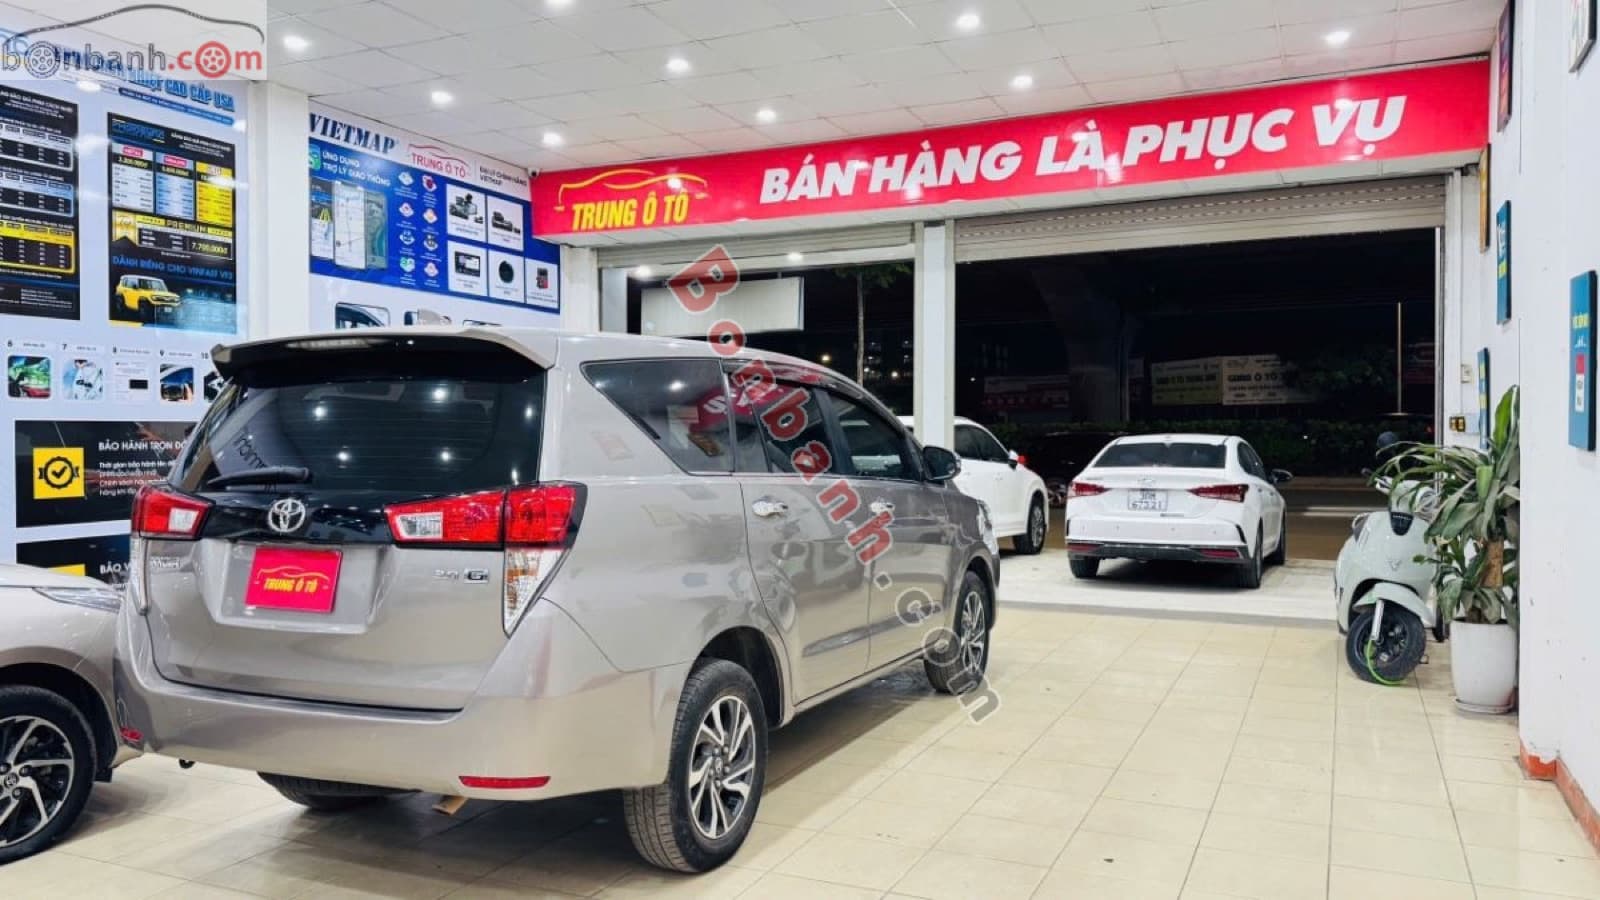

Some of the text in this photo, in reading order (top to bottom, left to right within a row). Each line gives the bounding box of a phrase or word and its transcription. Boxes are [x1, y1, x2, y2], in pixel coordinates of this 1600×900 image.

[165, 79, 187, 98] CAO
[213, 91, 235, 112] USA
[309, 112, 395, 154] VIETMAP
[411, 153, 443, 172] TRUNG
[759, 95, 1407, 204] BÁN HÀNG LÀ PHỤC VỤ
[572, 187, 689, 231] TRUNG Ô TÔ
[98, 439, 120, 451] BẢO
[121, 439, 148, 451] HÀNH
[100, 560, 121, 574] BẢO
[264, 577, 319, 593] TRUNG Ô TÔ
